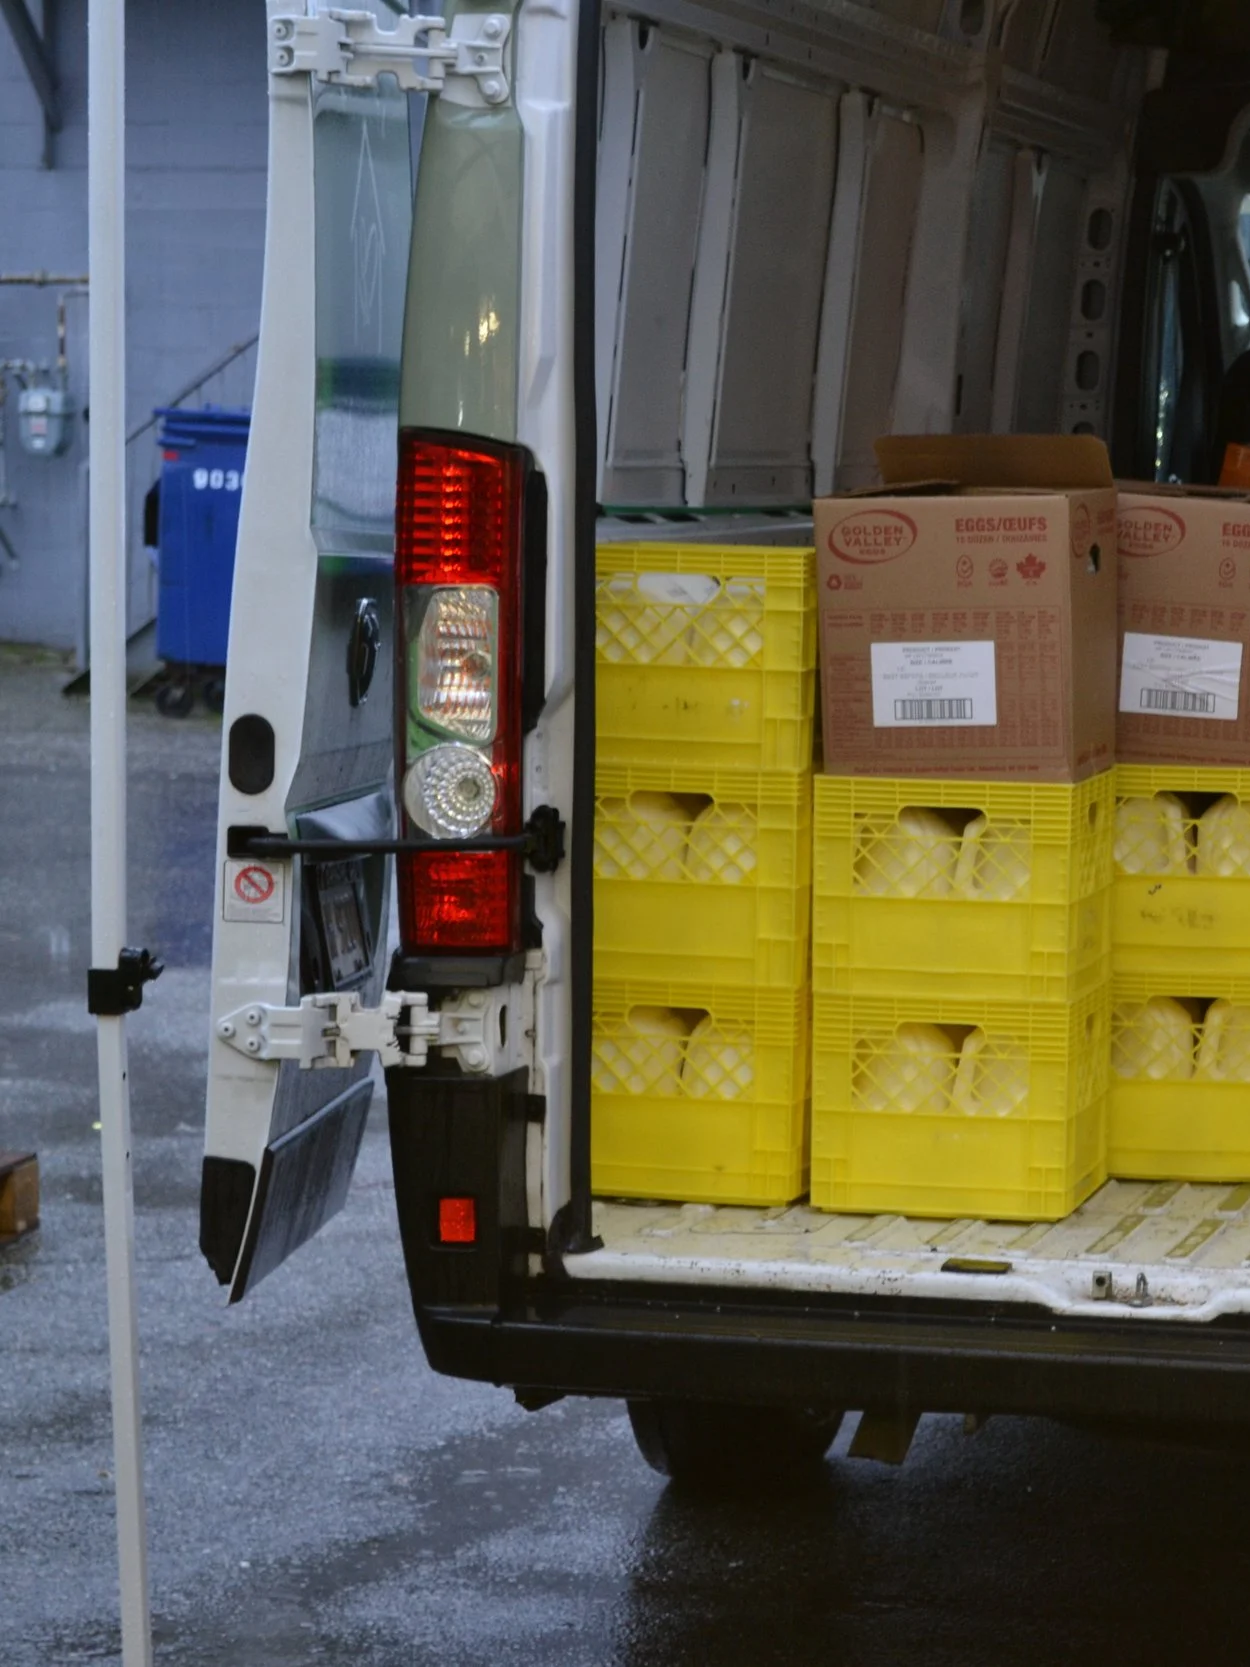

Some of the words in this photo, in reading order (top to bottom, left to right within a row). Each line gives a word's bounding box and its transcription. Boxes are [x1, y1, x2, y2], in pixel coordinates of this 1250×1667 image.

[193, 467, 244, 491] 903
[841, 525, 903, 536] GOLDEN
[955, 516, 1047, 532] EGGS/ŒUFS
[843, 536, 903, 547] VALLEY
